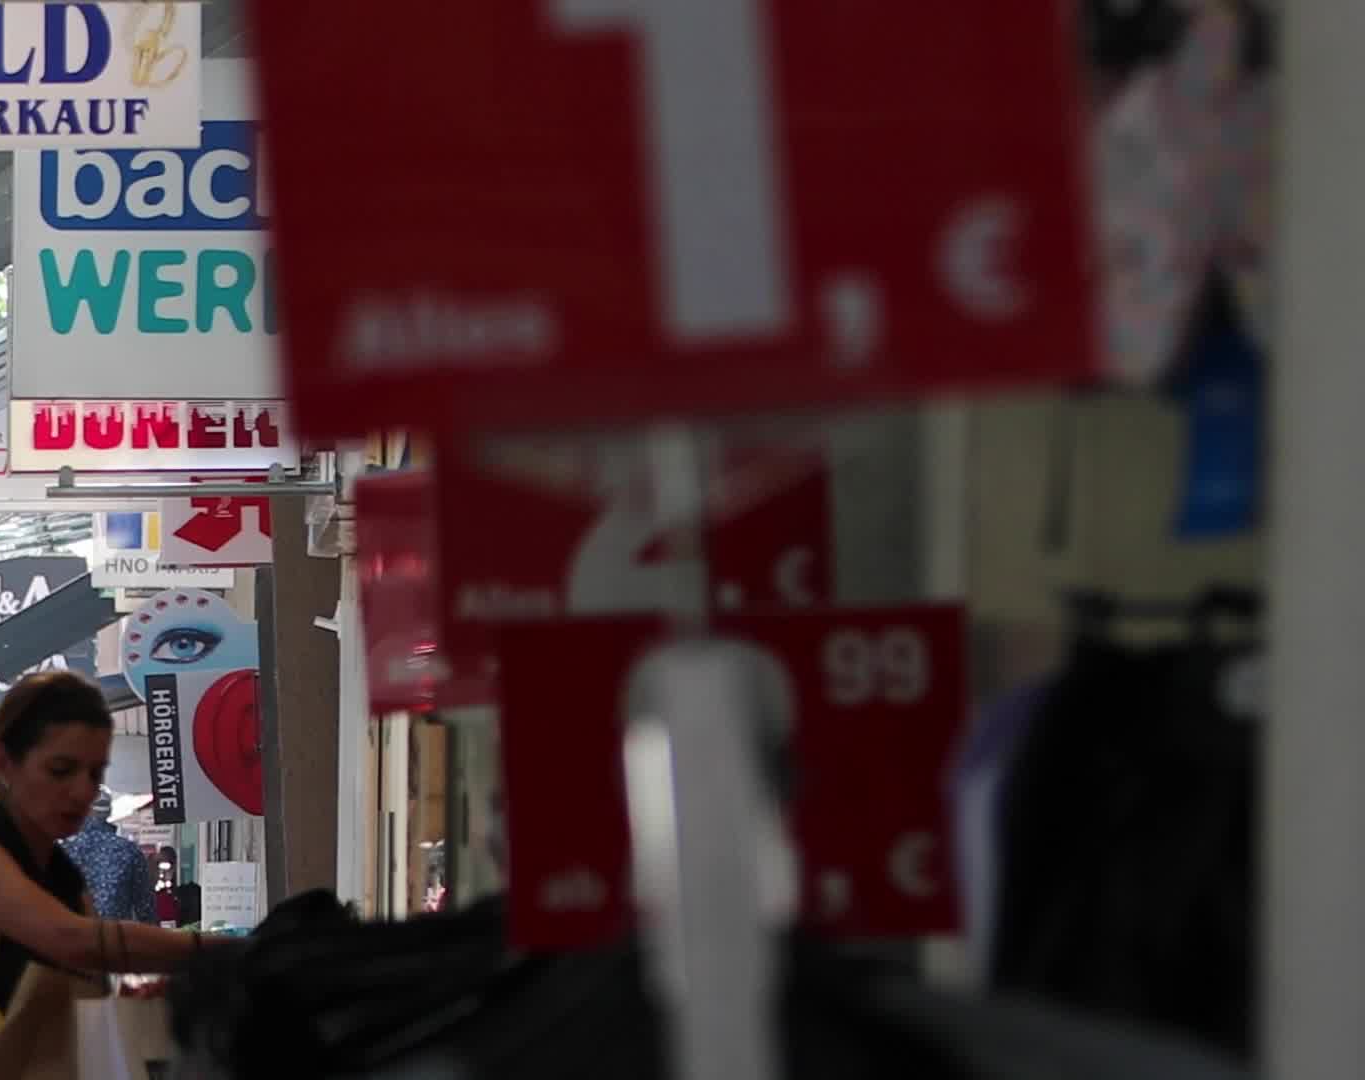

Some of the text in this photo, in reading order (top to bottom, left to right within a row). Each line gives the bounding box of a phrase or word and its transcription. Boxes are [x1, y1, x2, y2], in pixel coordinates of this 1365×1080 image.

[56, 149, 269, 220] bac
[39, 248, 277, 335] WER
[104, 558, 149, 575] HNO
[820, 626, 933, 705] 99
[152, 689, 180, 809] HÖRGERÄTE
